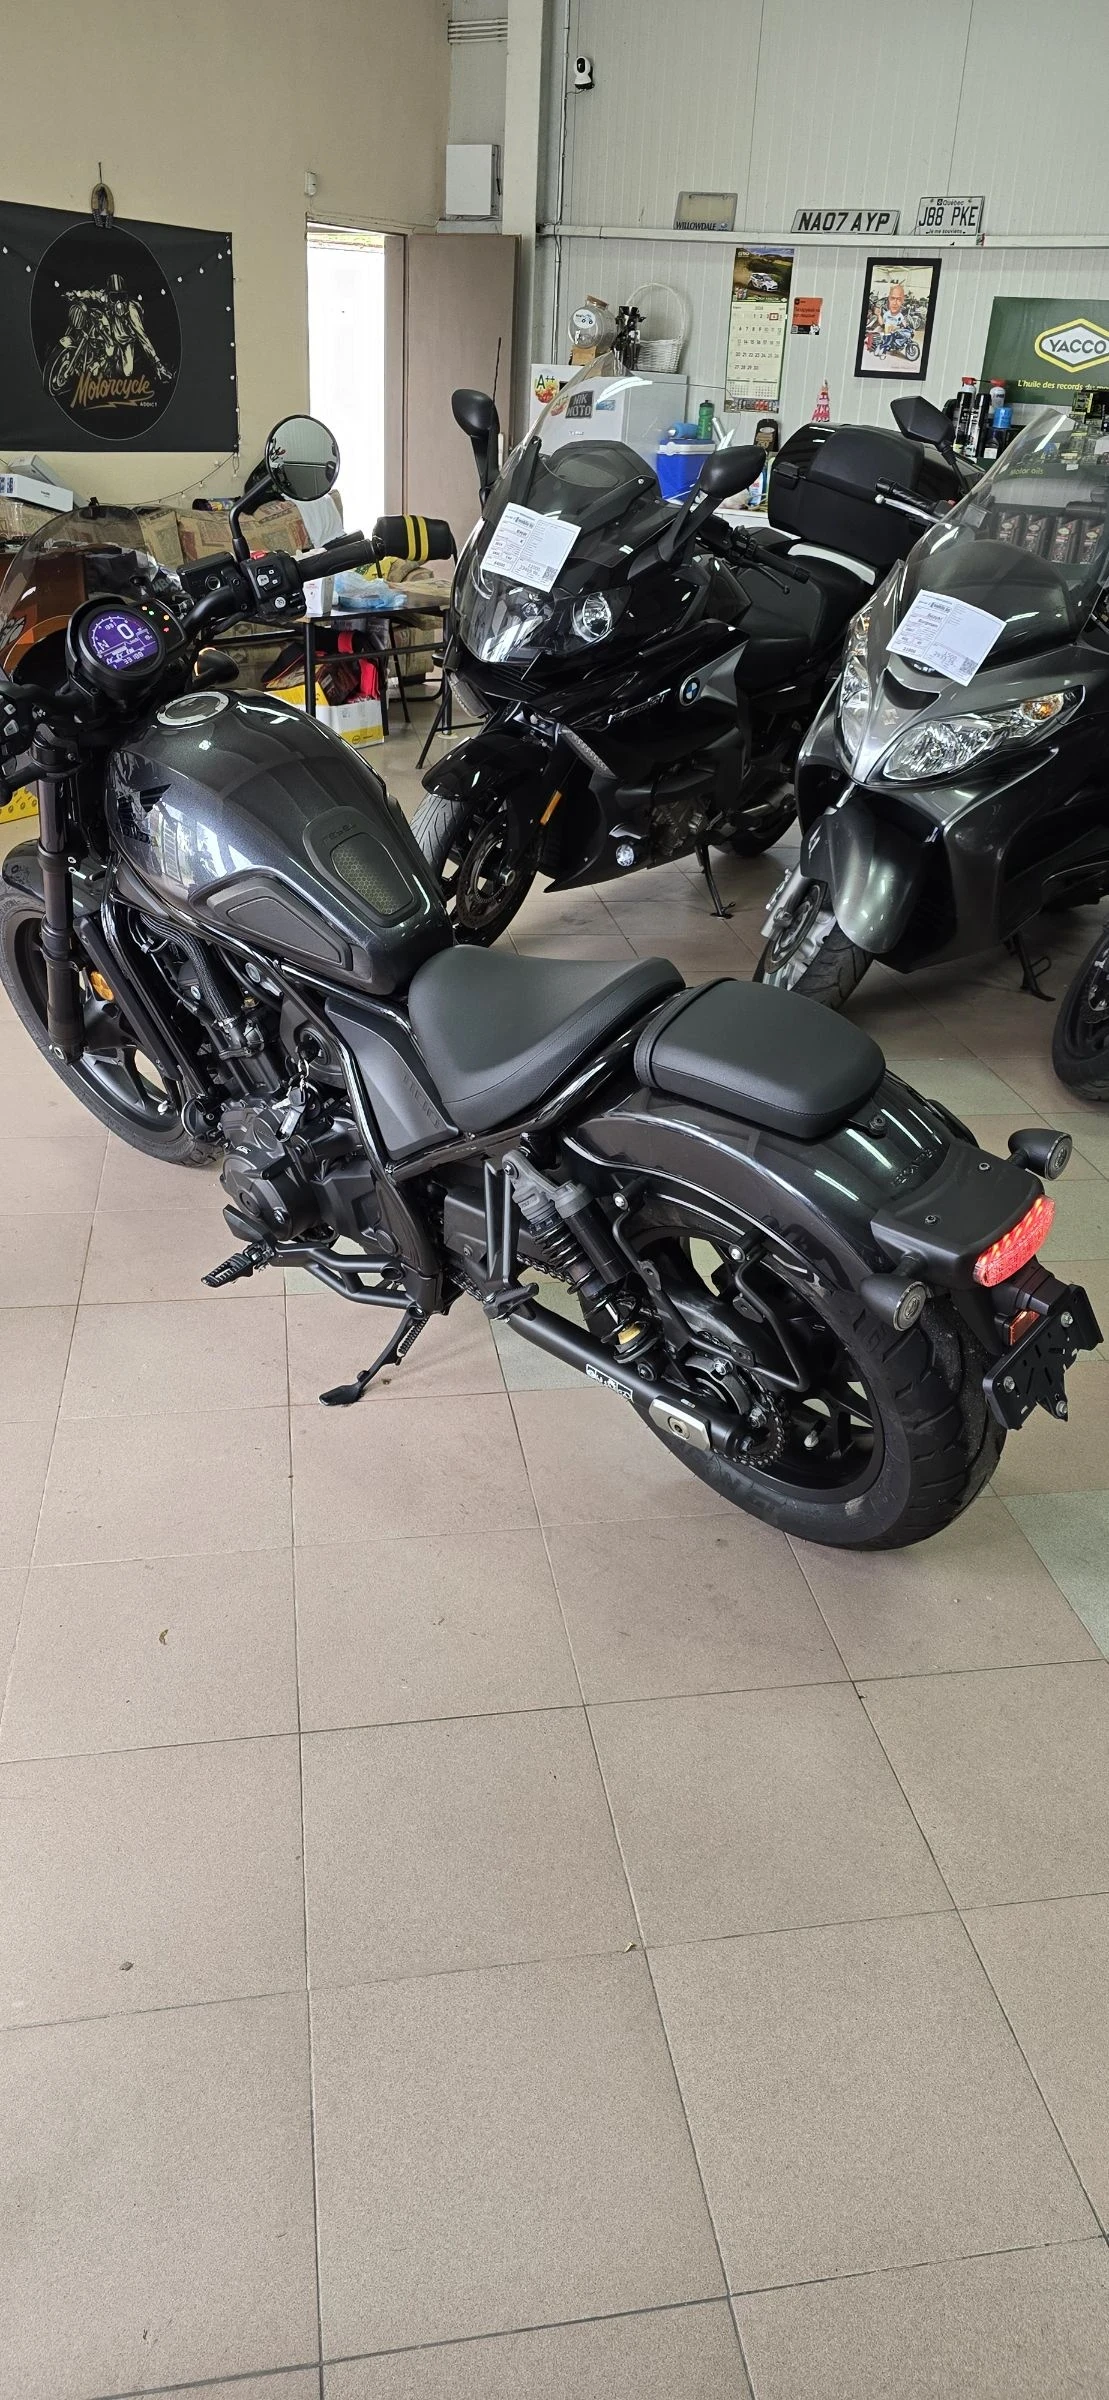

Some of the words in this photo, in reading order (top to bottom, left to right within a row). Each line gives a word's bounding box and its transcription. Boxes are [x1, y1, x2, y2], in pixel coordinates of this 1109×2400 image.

[850, 212, 890, 232] AYP
[919, 206, 944, 226] J88
[951, 206, 979, 226] PKE
[676, 221, 717, 230] WILLOWDALE
[1049, 339, 1107, 354] YACCO
[70, 372, 155, 408] Motorcycle
[1018, 379, 1041, 388] L'huile
[1042, 381, 1056, 389] des
[1056, 382, 1084, 391] records
[116, 623, 135, 640] 0
